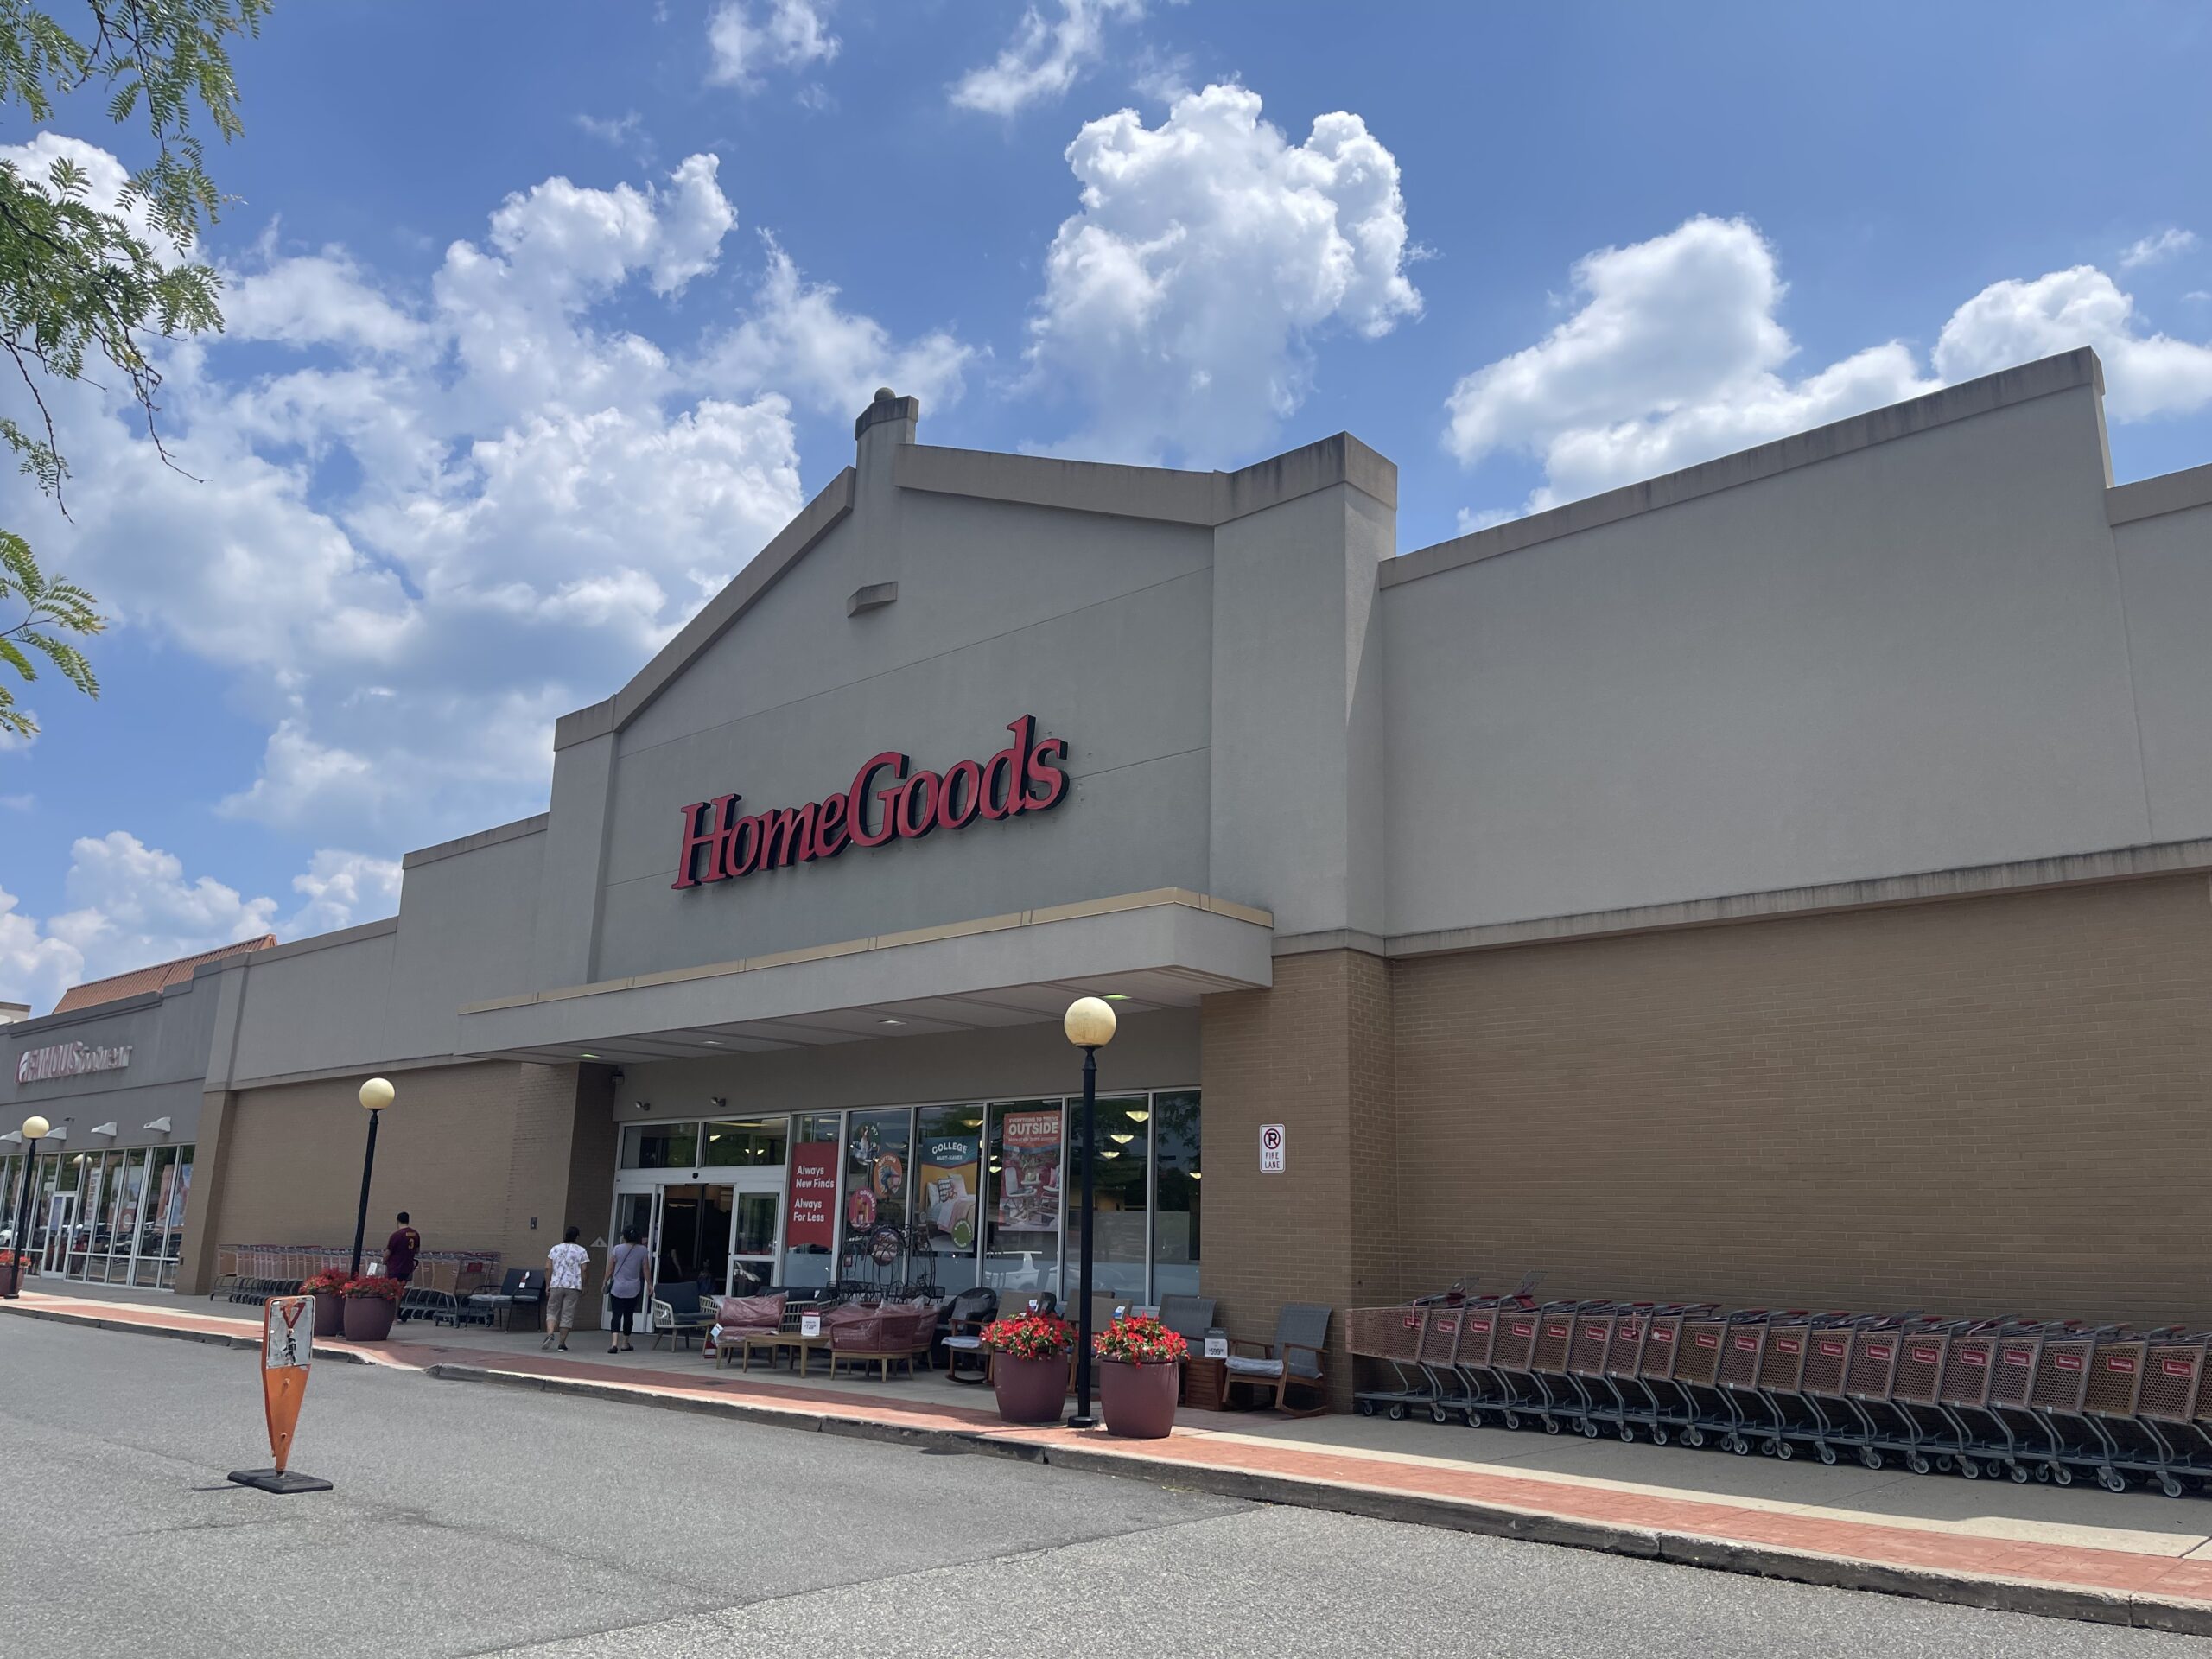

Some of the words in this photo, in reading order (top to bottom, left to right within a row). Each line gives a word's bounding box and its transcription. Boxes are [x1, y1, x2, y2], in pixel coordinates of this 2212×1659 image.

[672, 714, 1070, 889] HomeGoods
[1008, 1122, 1058, 1135] OUTSIDE
[932, 1142, 968, 1154] COLLEGE
[797, 1165, 824, 1177] Always
[796, 1179, 812, 1188] New
[813, 1178, 835, 1188] Finds
[794, 1198, 822, 1211] Always
[793, 1211, 806, 1222] For
[807, 1212, 825, 1222] Less
[408, 1238, 415, 1249] 3
